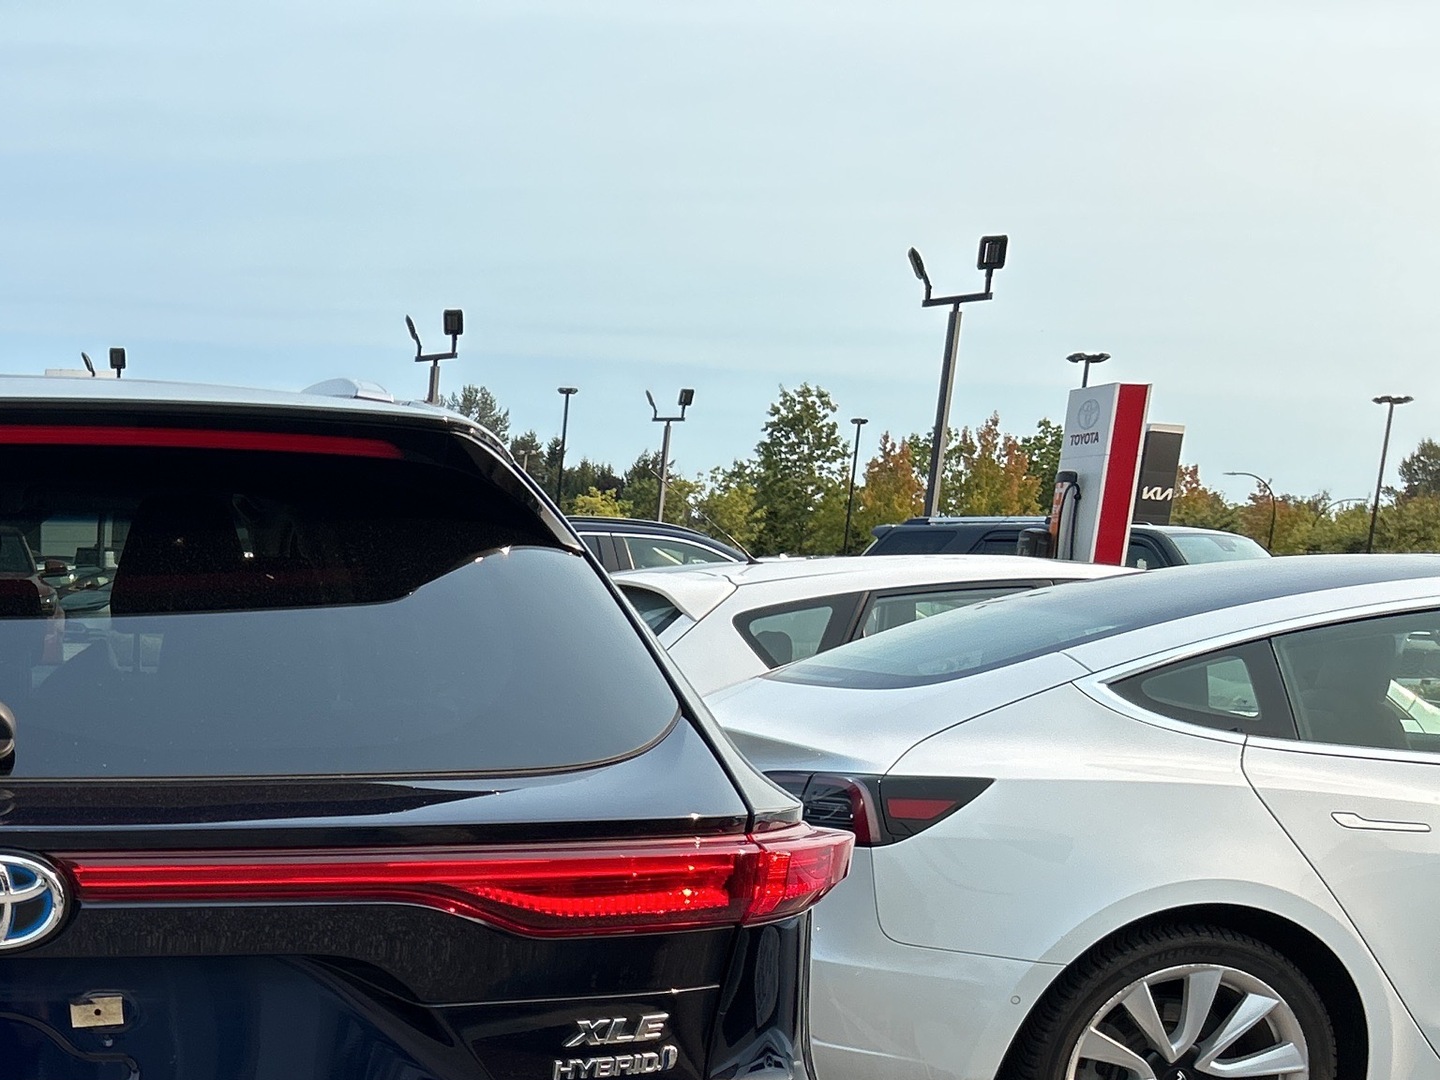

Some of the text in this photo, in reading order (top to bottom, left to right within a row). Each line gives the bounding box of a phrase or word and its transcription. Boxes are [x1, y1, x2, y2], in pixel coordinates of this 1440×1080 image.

[1070, 432, 1099, 446] TOYOTA
[1142, 486, 1173, 501] KIA
[561, 1012, 670, 1048] XLE
[552, 1052, 661, 1080] HYBRID
